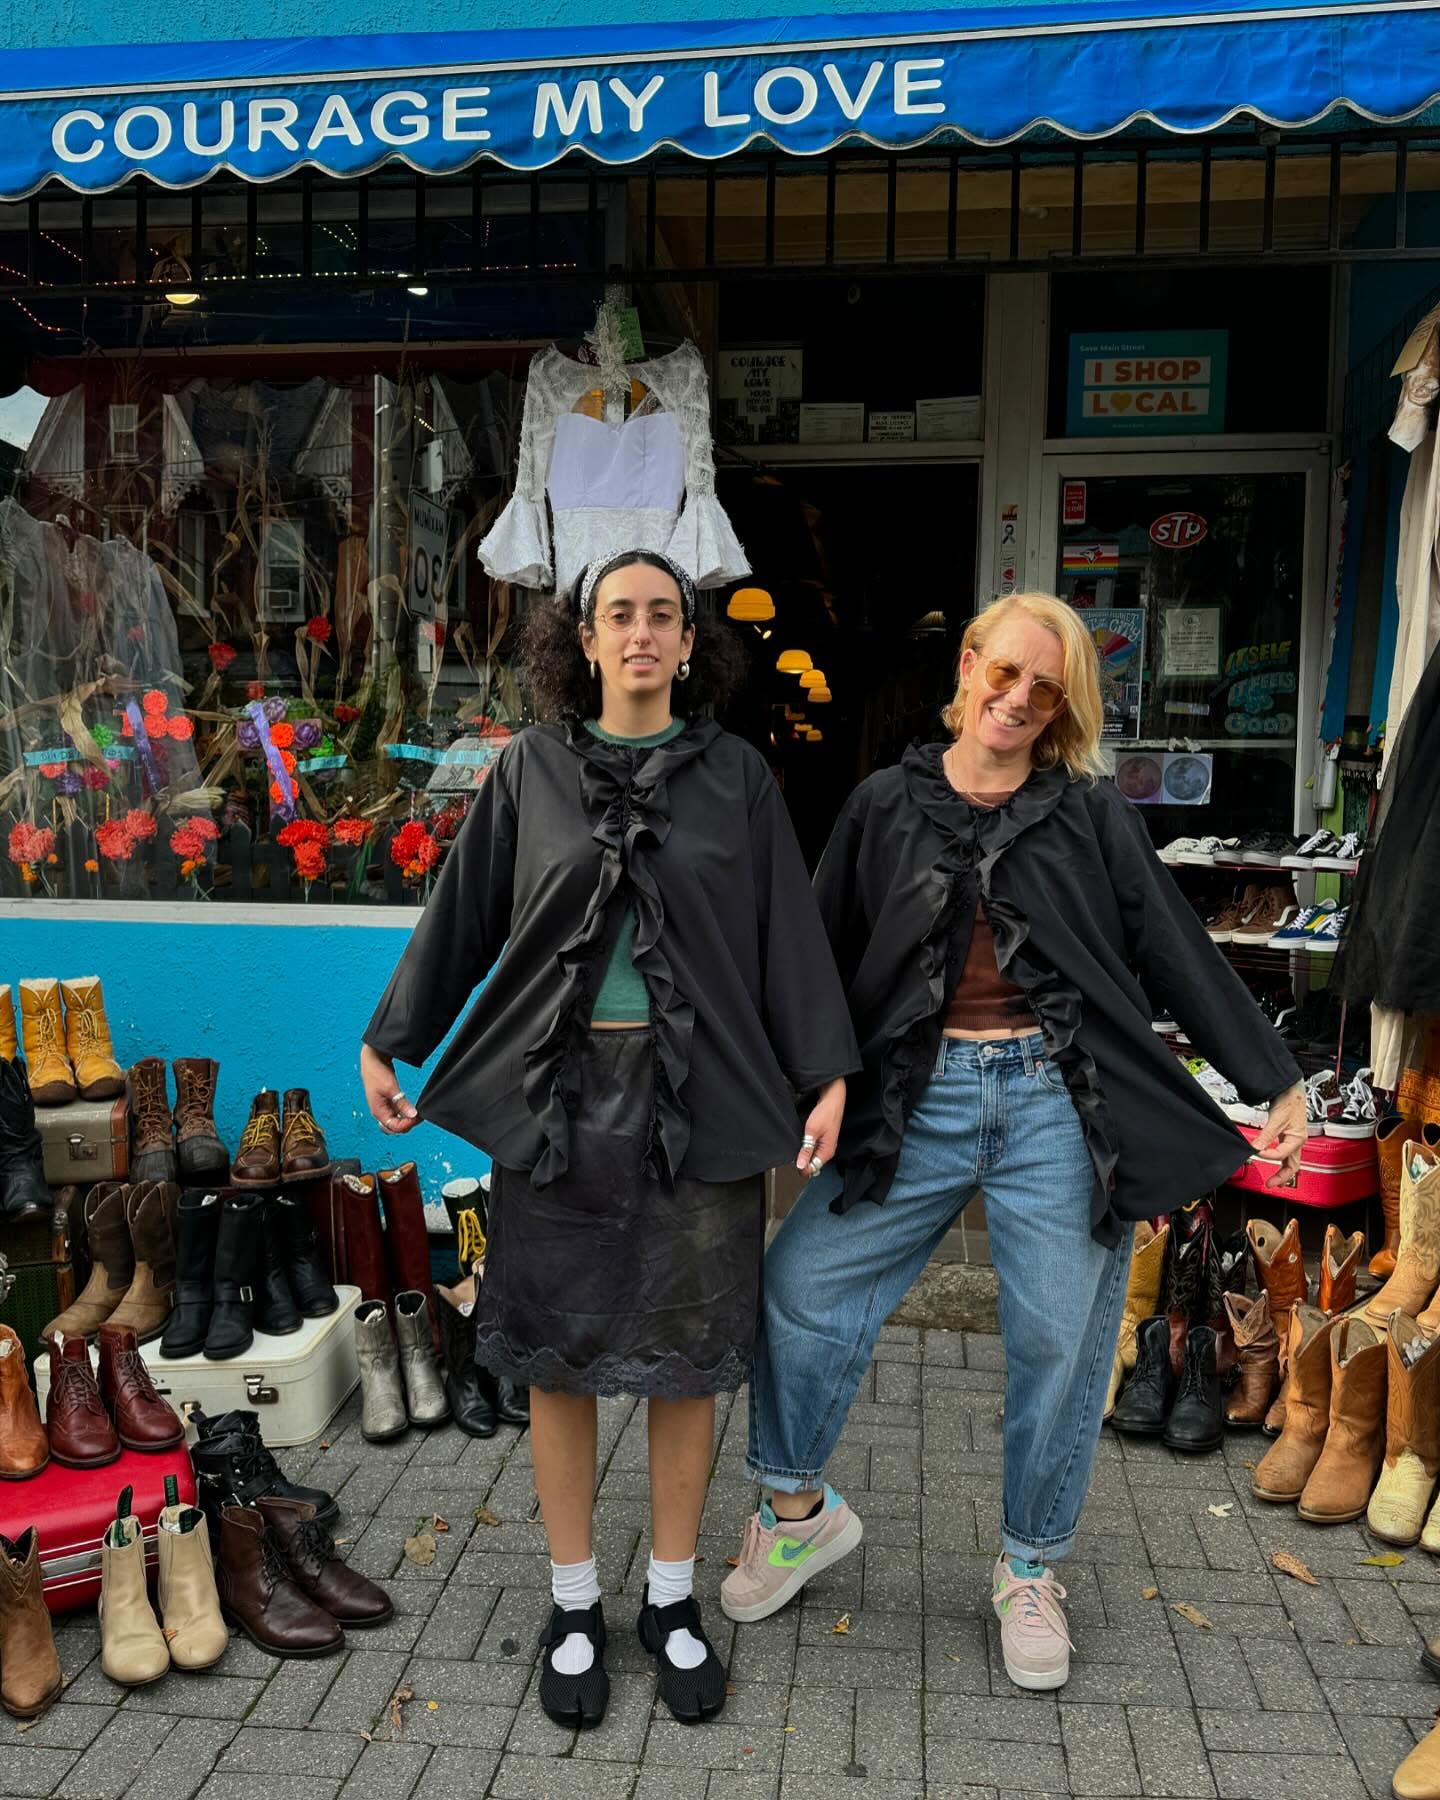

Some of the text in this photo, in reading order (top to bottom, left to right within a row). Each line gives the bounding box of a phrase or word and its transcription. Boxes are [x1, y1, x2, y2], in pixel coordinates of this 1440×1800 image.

[52, 58, 946, 164] COURAGE MY LOVE
[1080, 343, 1145, 353] Save Main Street
[1094, 359, 1202, 383] I SHOP
[1155, 515, 1201, 544] STP
[1224, 640, 1292, 673] ITSELF
[1224, 711, 1296, 736] GOOD
